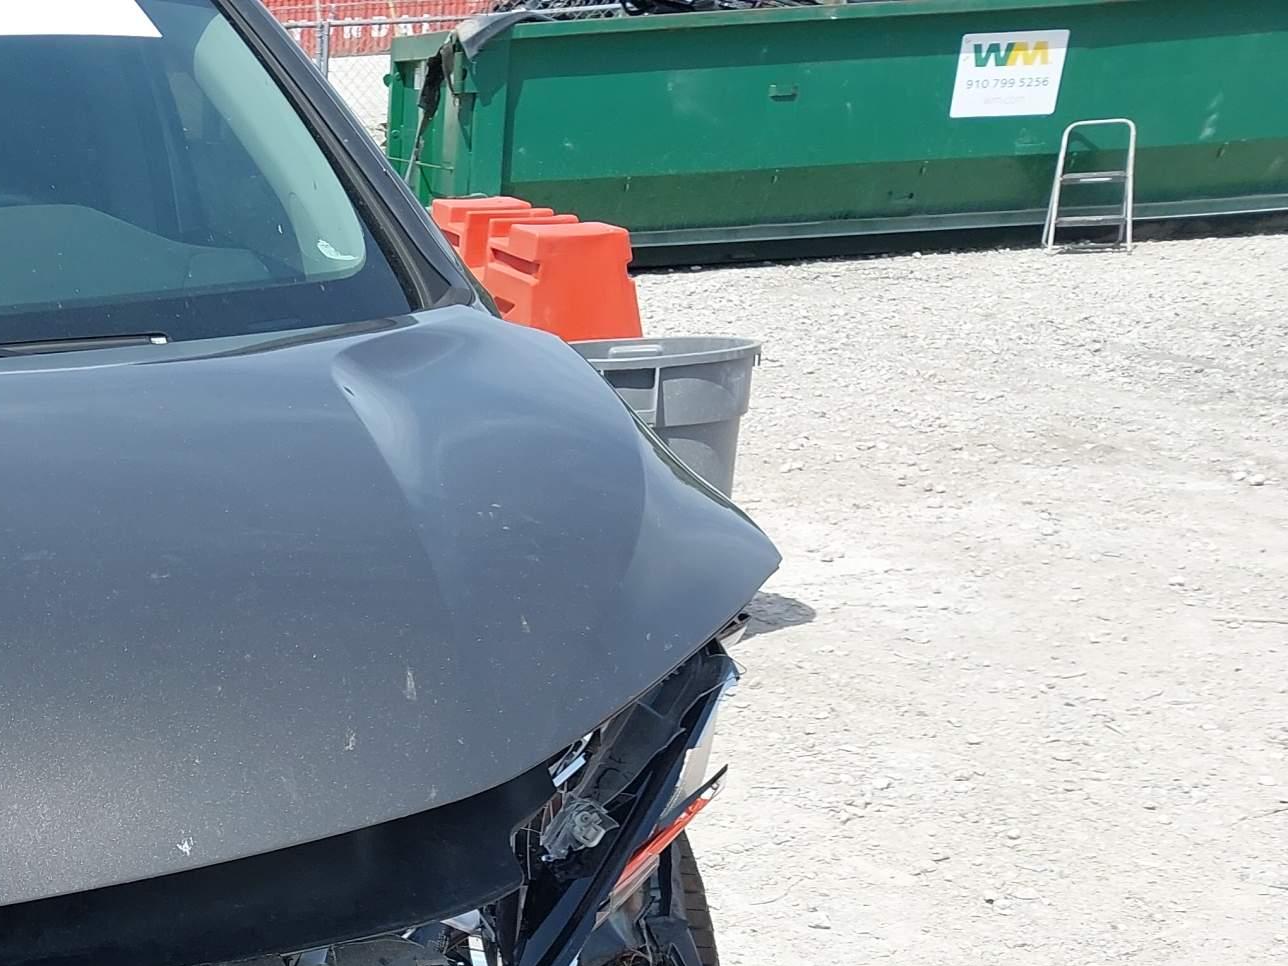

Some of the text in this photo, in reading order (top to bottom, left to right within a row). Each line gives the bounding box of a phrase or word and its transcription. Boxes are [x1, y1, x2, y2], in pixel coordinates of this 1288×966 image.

[974, 41, 1050, 67] WM
[965, 77, 1050, 89] 910 799 5256
